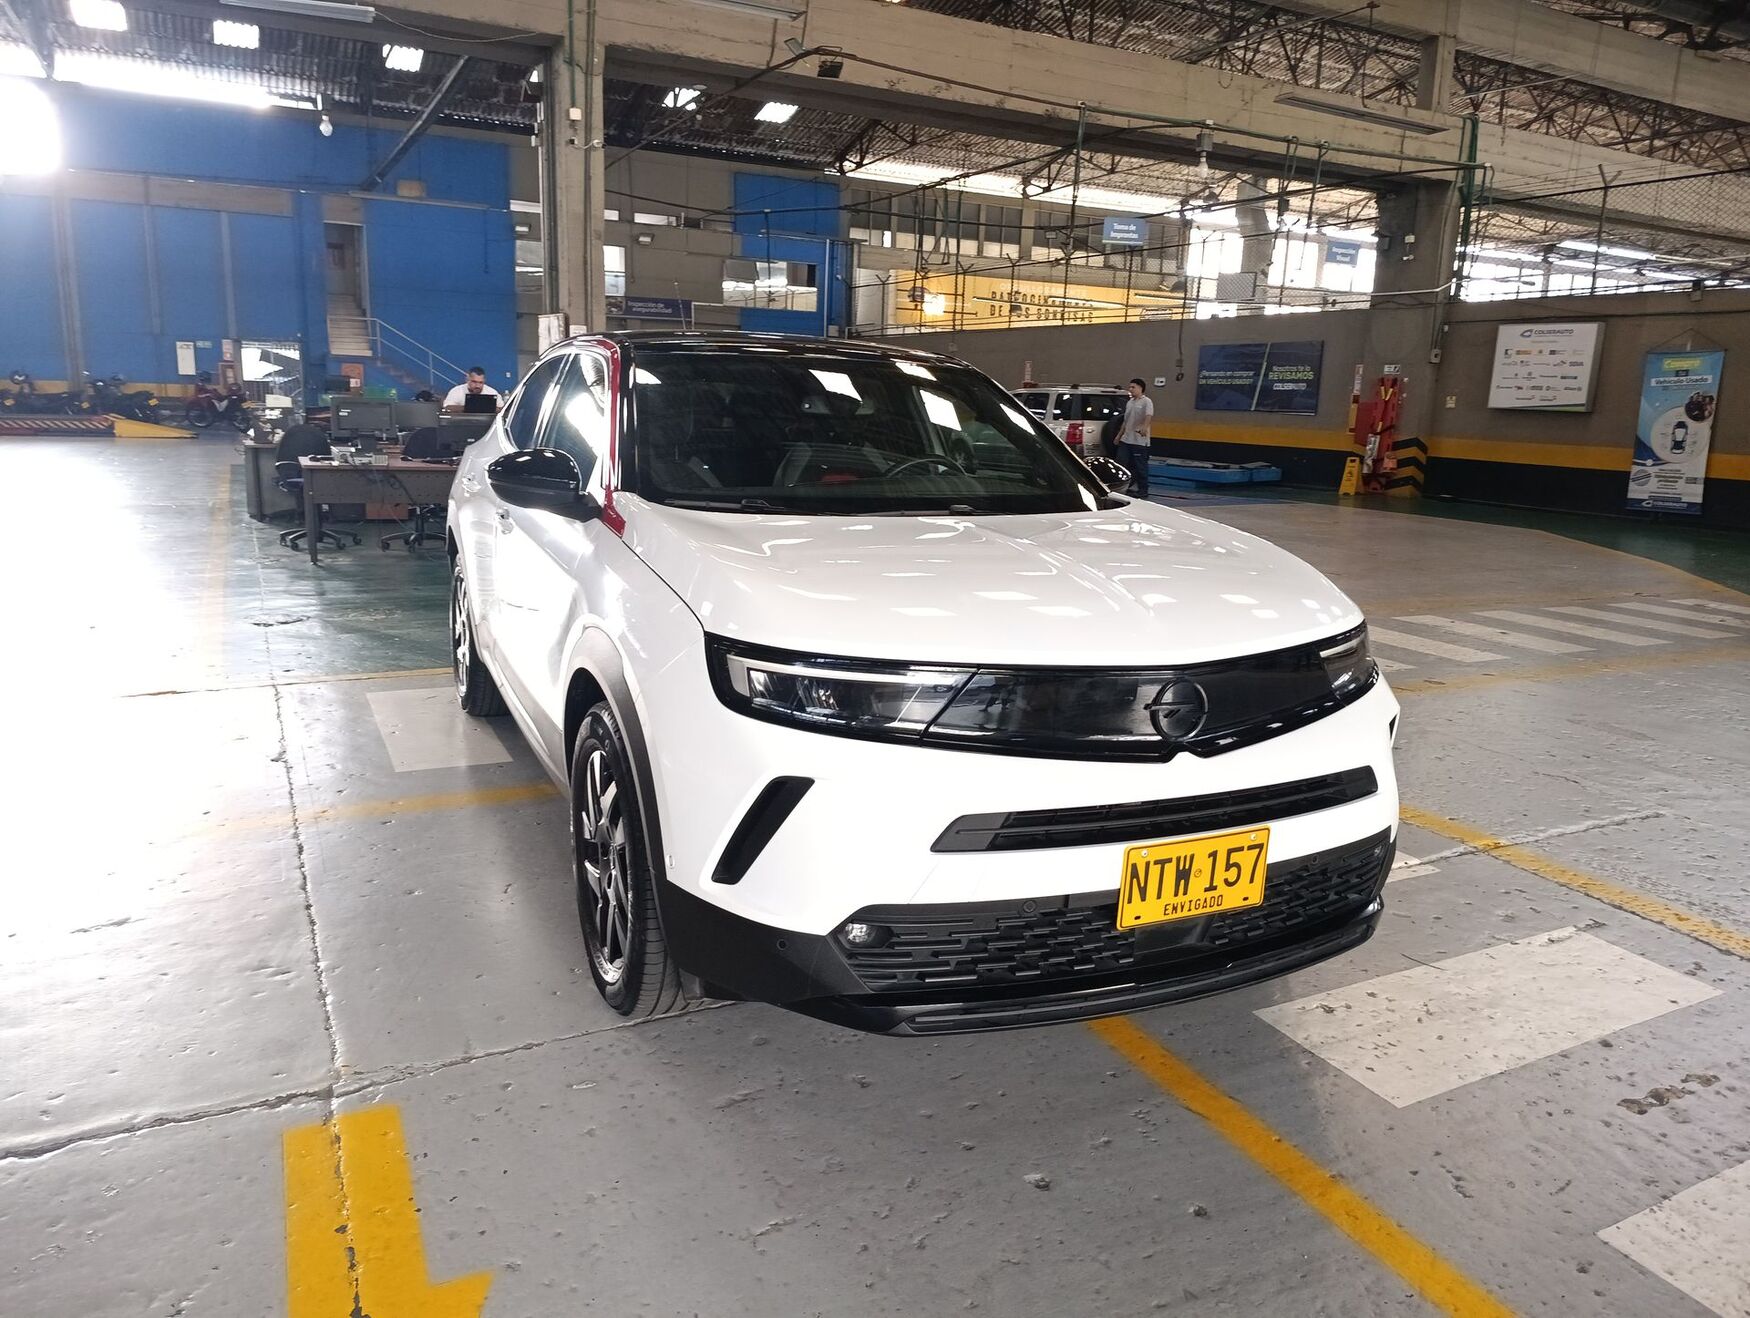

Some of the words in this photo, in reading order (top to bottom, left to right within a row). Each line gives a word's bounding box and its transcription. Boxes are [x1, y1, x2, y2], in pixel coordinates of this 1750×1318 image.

[1268, 372, 1314, 380] REVISAMOS
[1127, 853, 1195, 905] NTW
[1204, 843, 1265, 893] 157
[1164, 894, 1224, 916] ENVIGADO
